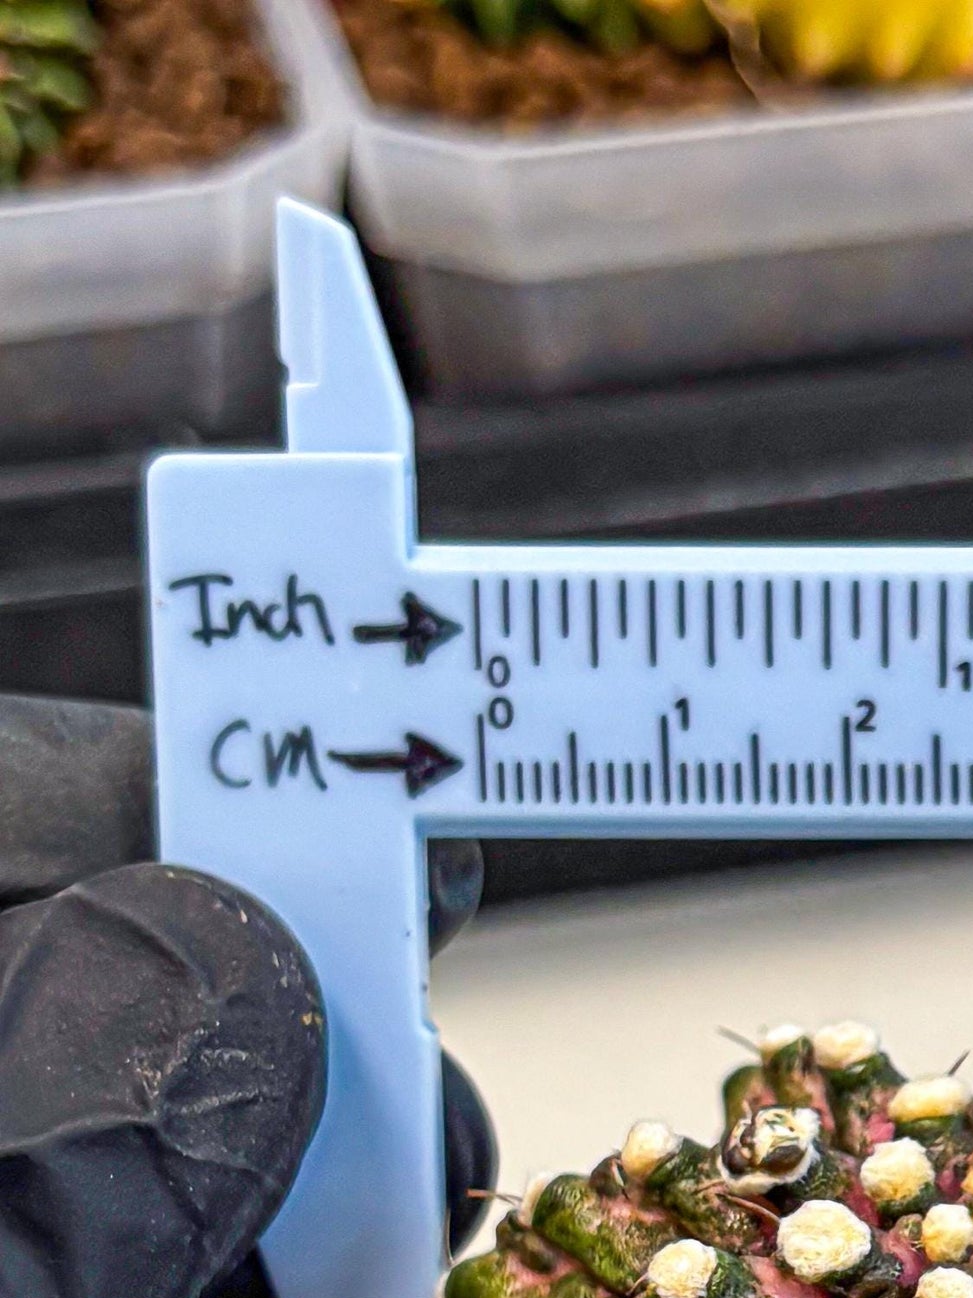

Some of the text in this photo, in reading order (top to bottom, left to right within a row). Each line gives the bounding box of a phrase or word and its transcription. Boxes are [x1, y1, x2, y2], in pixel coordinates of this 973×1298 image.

[168, 573, 336, 648] Inch
[487, 655, 511, 689] 0
[955, 661, 972, 692] 1
[488, 696, 515, 730] 0
[674, 697, 690, 732] 1
[854, 699, 877, 733] 2
